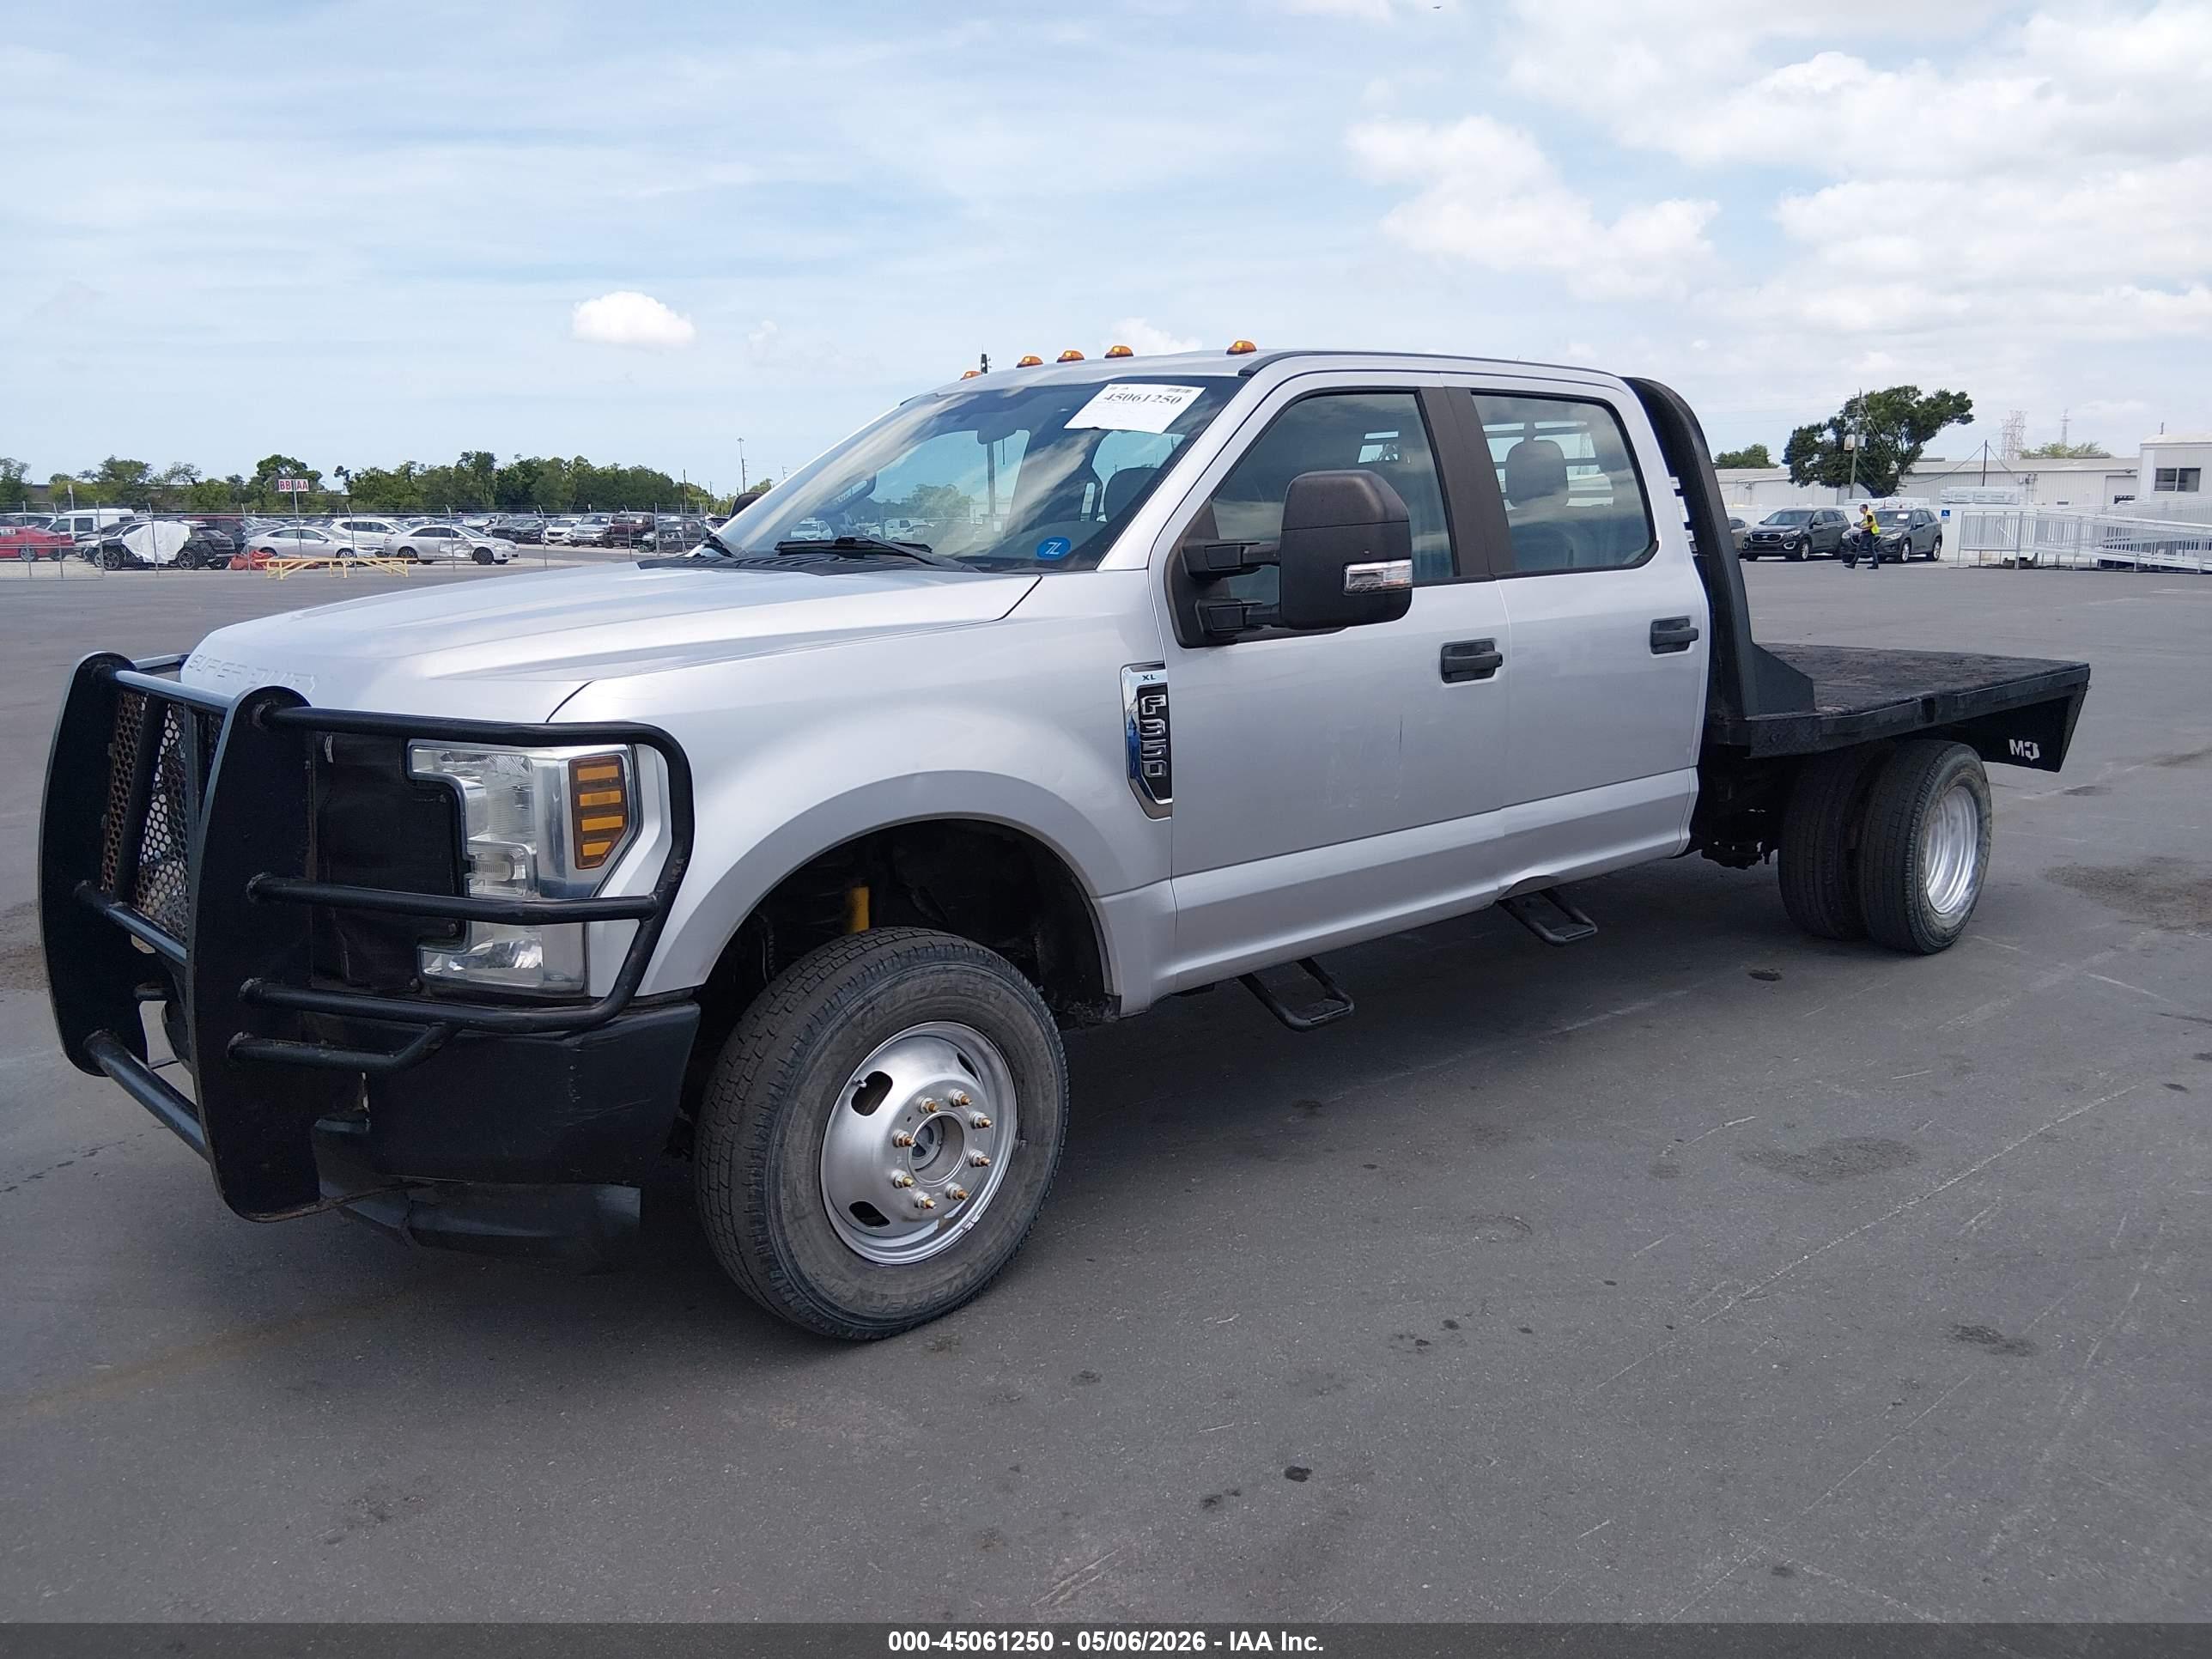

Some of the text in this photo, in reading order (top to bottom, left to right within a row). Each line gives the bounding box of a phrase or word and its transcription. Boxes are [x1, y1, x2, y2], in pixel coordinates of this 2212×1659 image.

[1103, 392, 1182, 405] 45061250
[279, 480, 308, 490] BB AA
